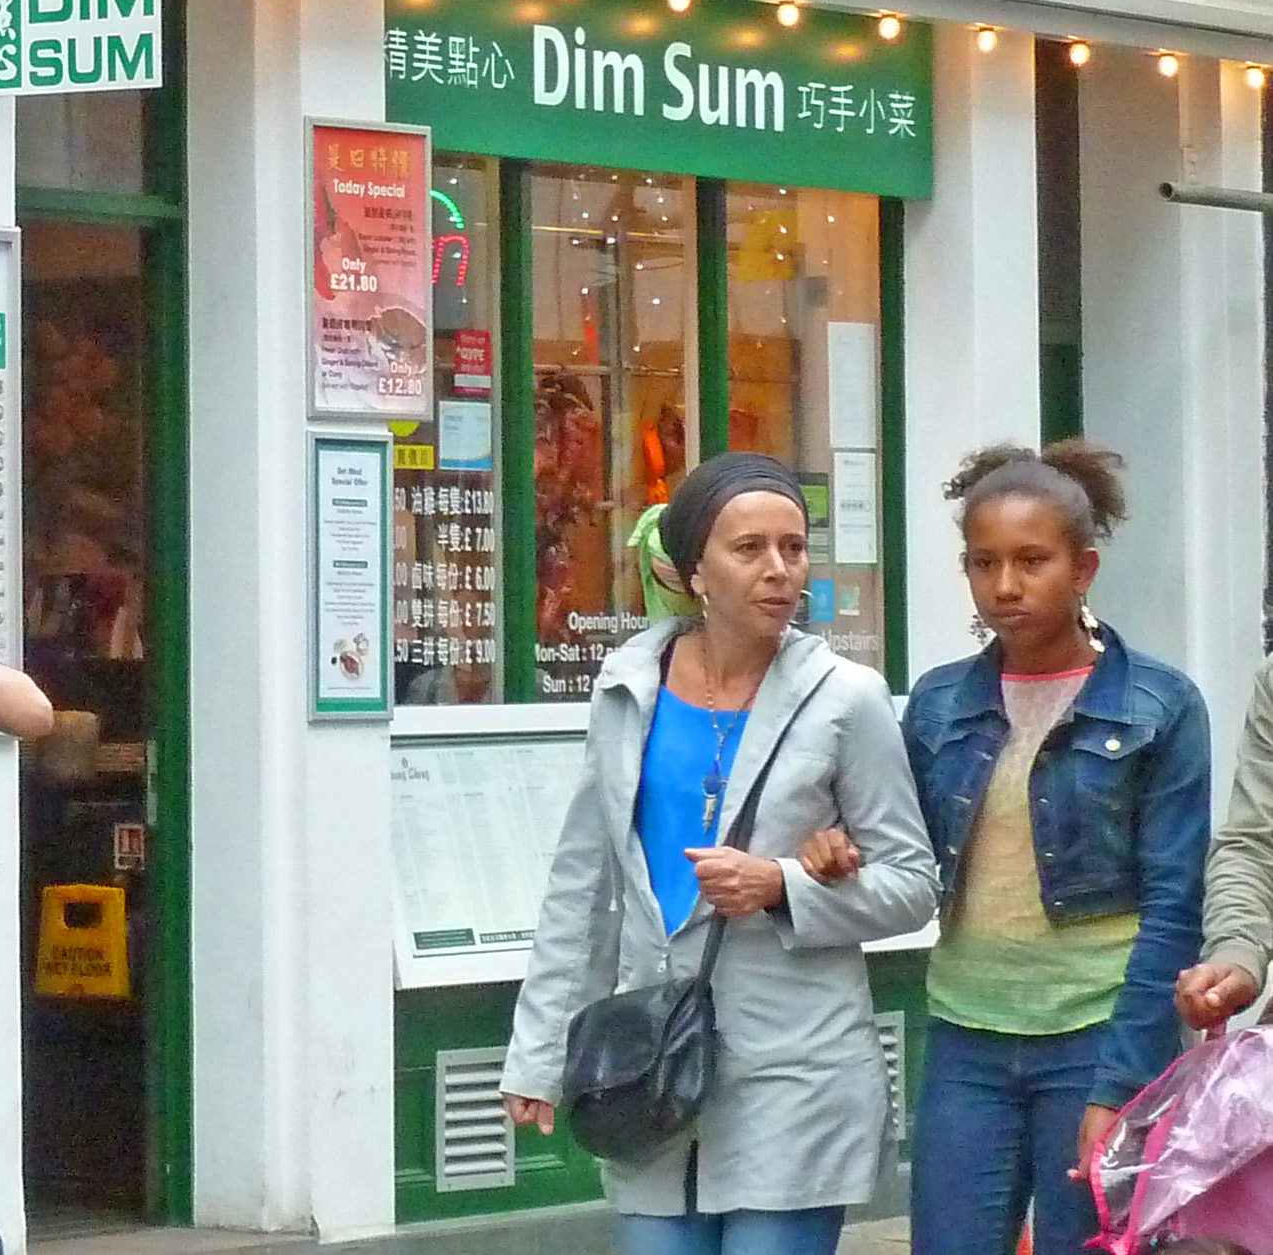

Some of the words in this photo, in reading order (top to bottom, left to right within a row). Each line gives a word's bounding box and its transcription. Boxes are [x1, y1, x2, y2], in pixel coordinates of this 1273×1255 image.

[29, 33, 153, 87] SUM
[533, 25, 645, 116] Dim
[662, 42, 784, 132] Sum
[797, 82, 916, 138] 巧手小菜
[333, 179, 365, 198] Today
[368, 181, 405, 199] Special
[342, 258, 365, 274] Only
[331, 274, 378, 293] £21.80
[390, 362, 411, 377] Only
[568, 612, 618, 633] Opening
[543, 676, 566, 693] Sun
[576, 674, 590, 692] 12
